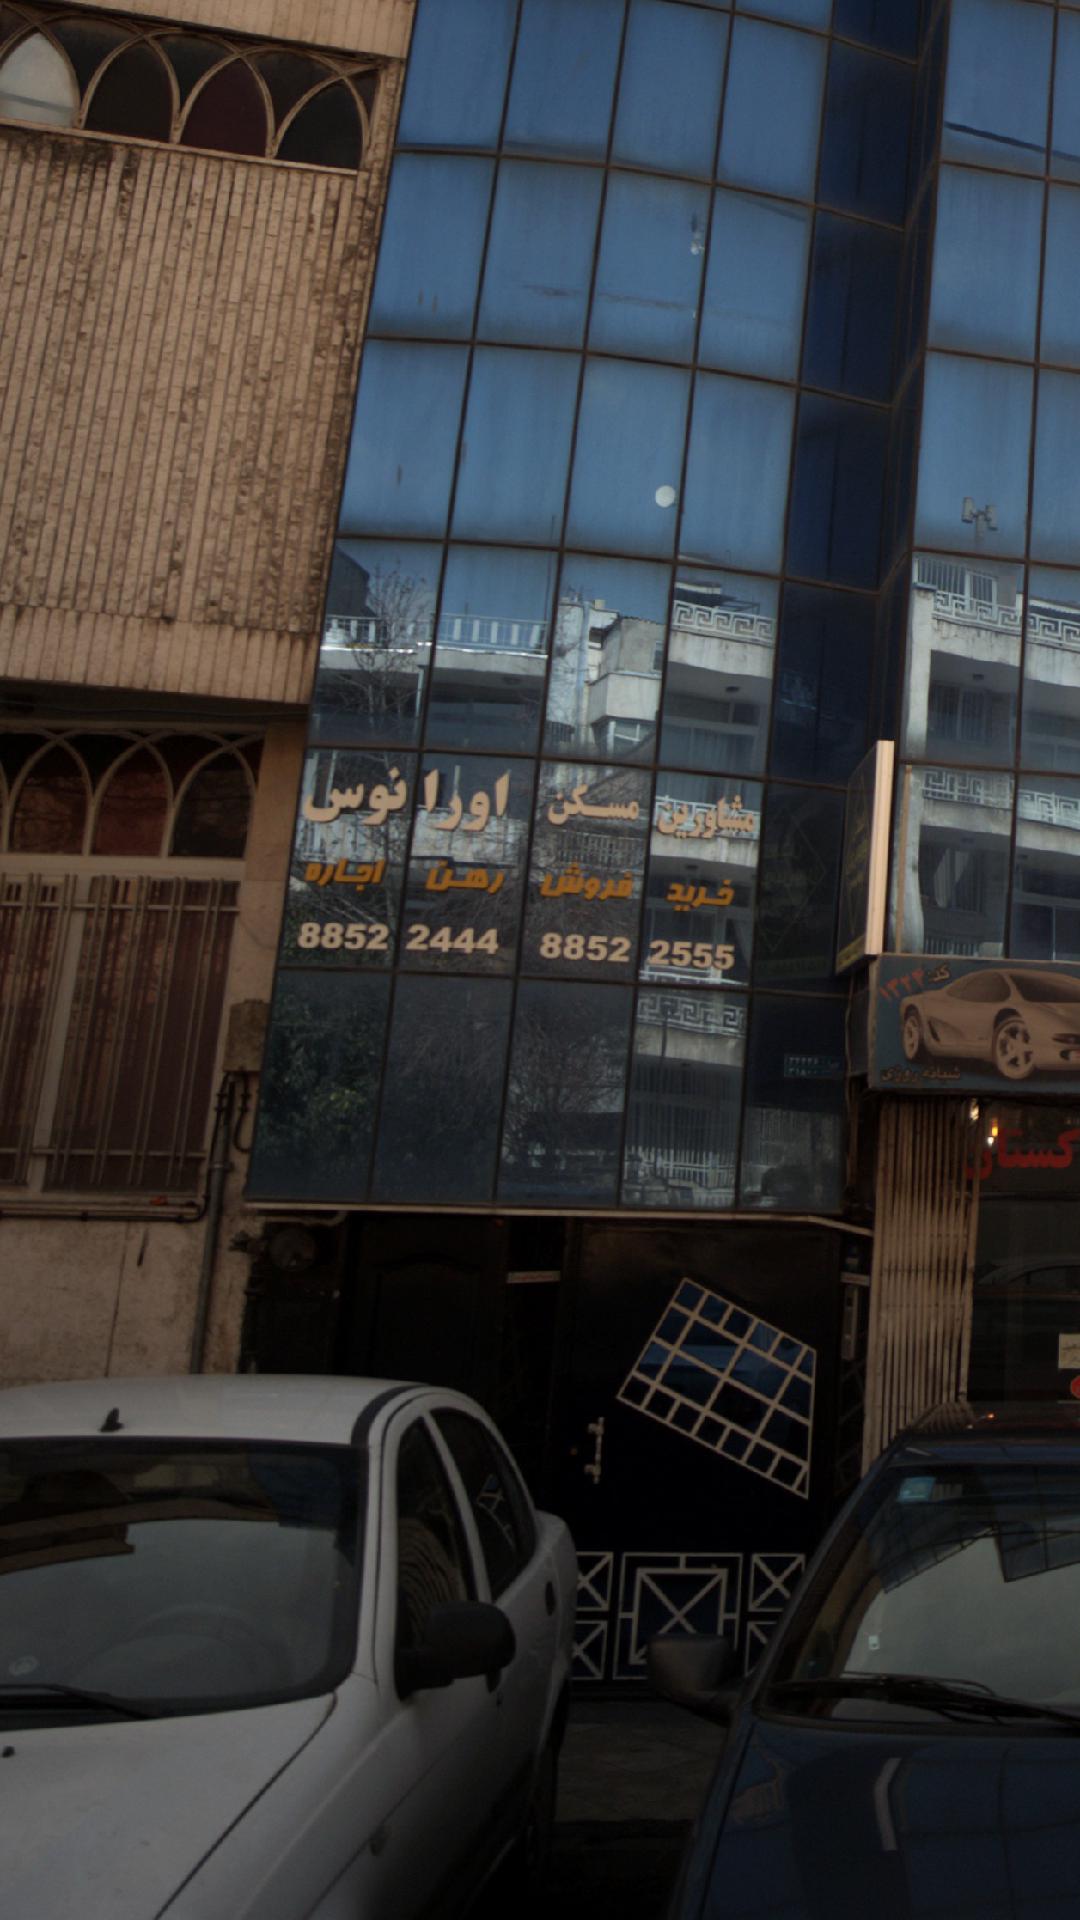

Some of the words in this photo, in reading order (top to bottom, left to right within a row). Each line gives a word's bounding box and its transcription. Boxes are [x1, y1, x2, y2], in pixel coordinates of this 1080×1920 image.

[546, 784, 641, 826] مسکن
[303, 858, 386, 891] اجاره
[425, 859, 506, 895] رهن
[540, 857, 634, 900] فروش
[666, 878, 736, 912] خرید
[298, 921, 390, 951] 8852
[406, 924, 500, 955] 2444
[539, 932, 632, 962] 8852
[648, 940, 736, 970] 2555
